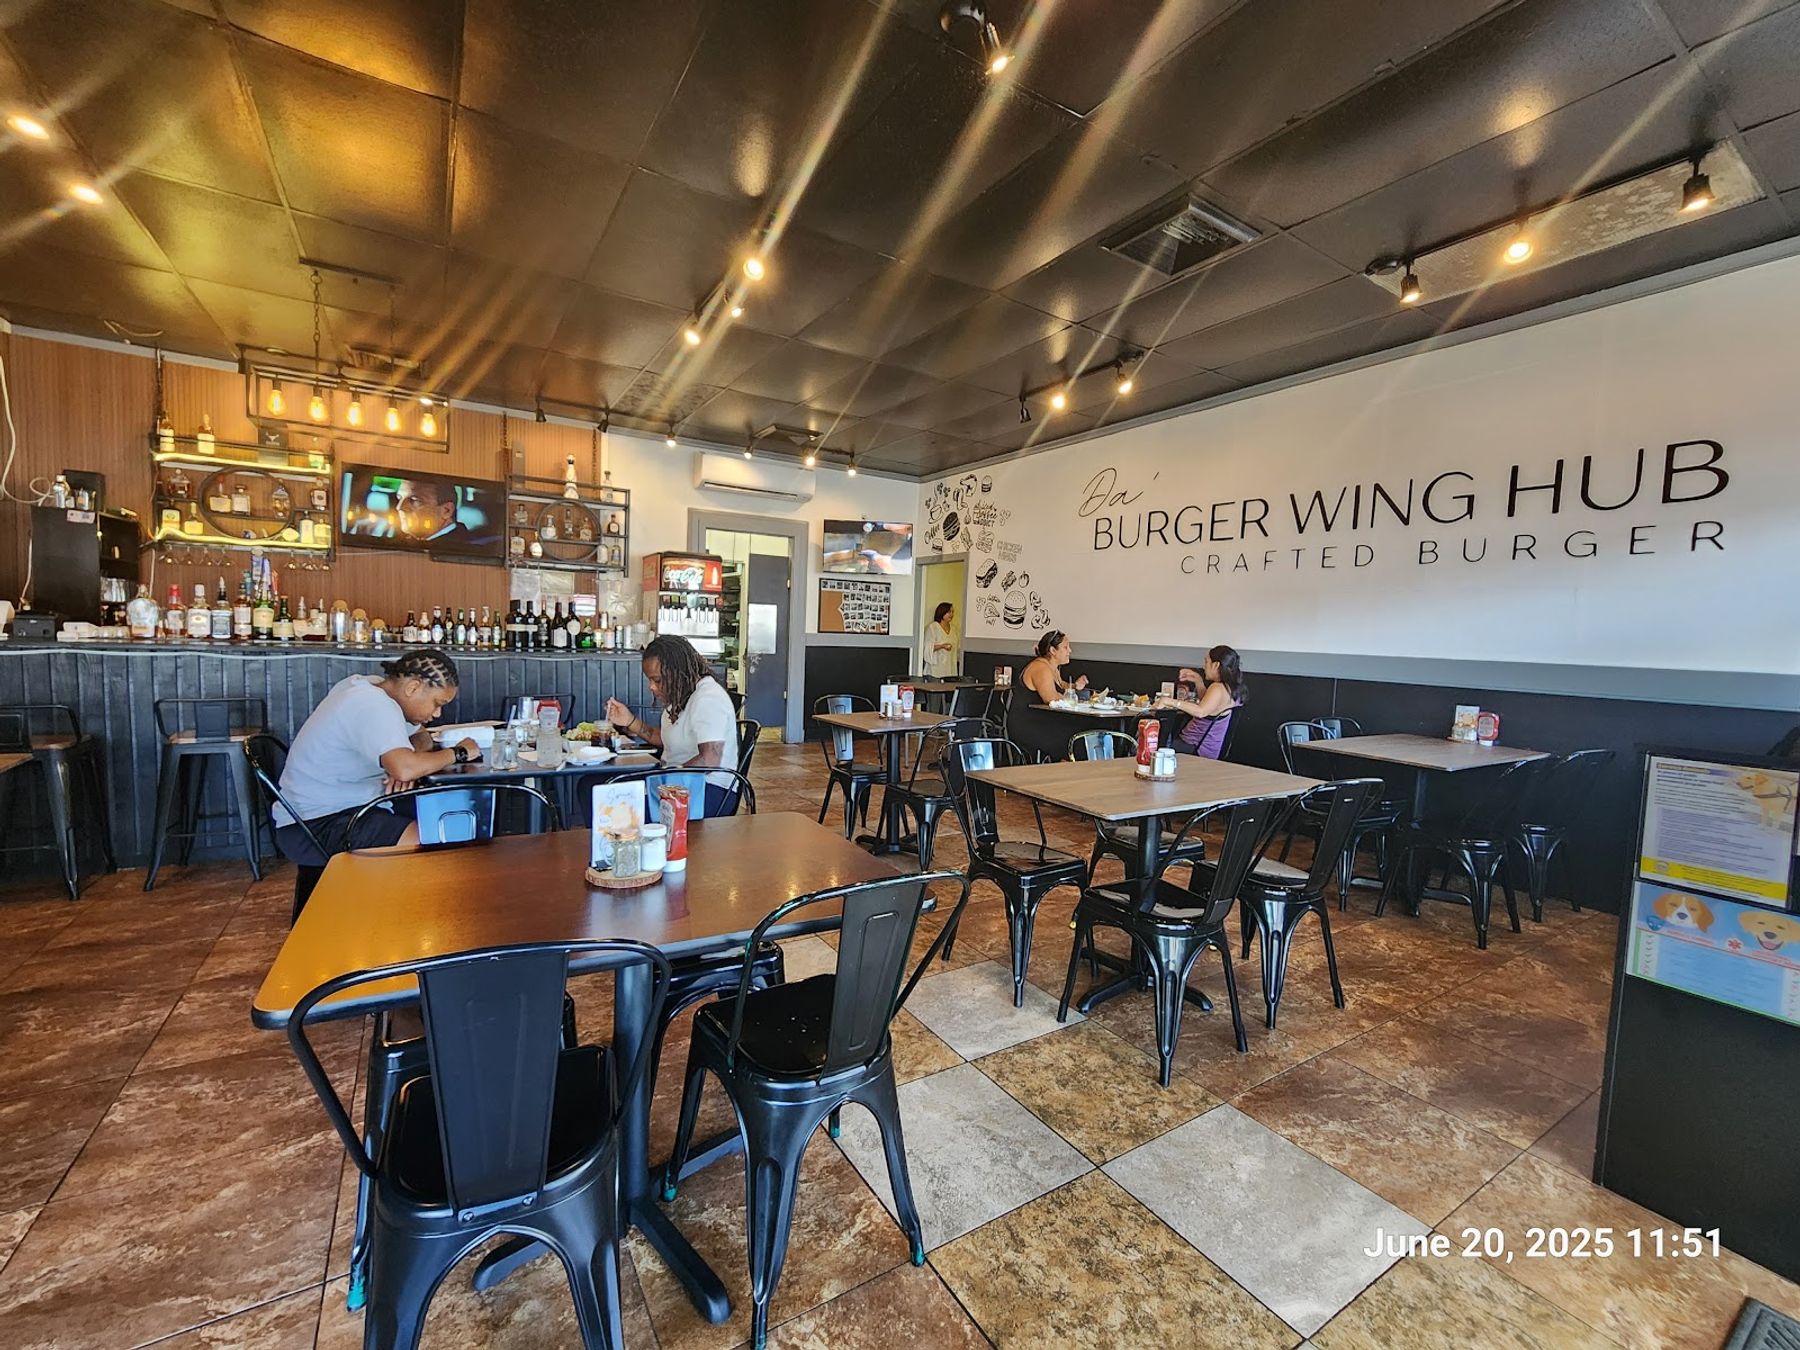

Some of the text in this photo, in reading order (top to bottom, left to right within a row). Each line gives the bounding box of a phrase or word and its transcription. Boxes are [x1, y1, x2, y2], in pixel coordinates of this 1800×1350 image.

[1093, 439, 1730, 551] BURGER WING HUB
[1180, 521, 1725, 575] CRAFTED BURGER
